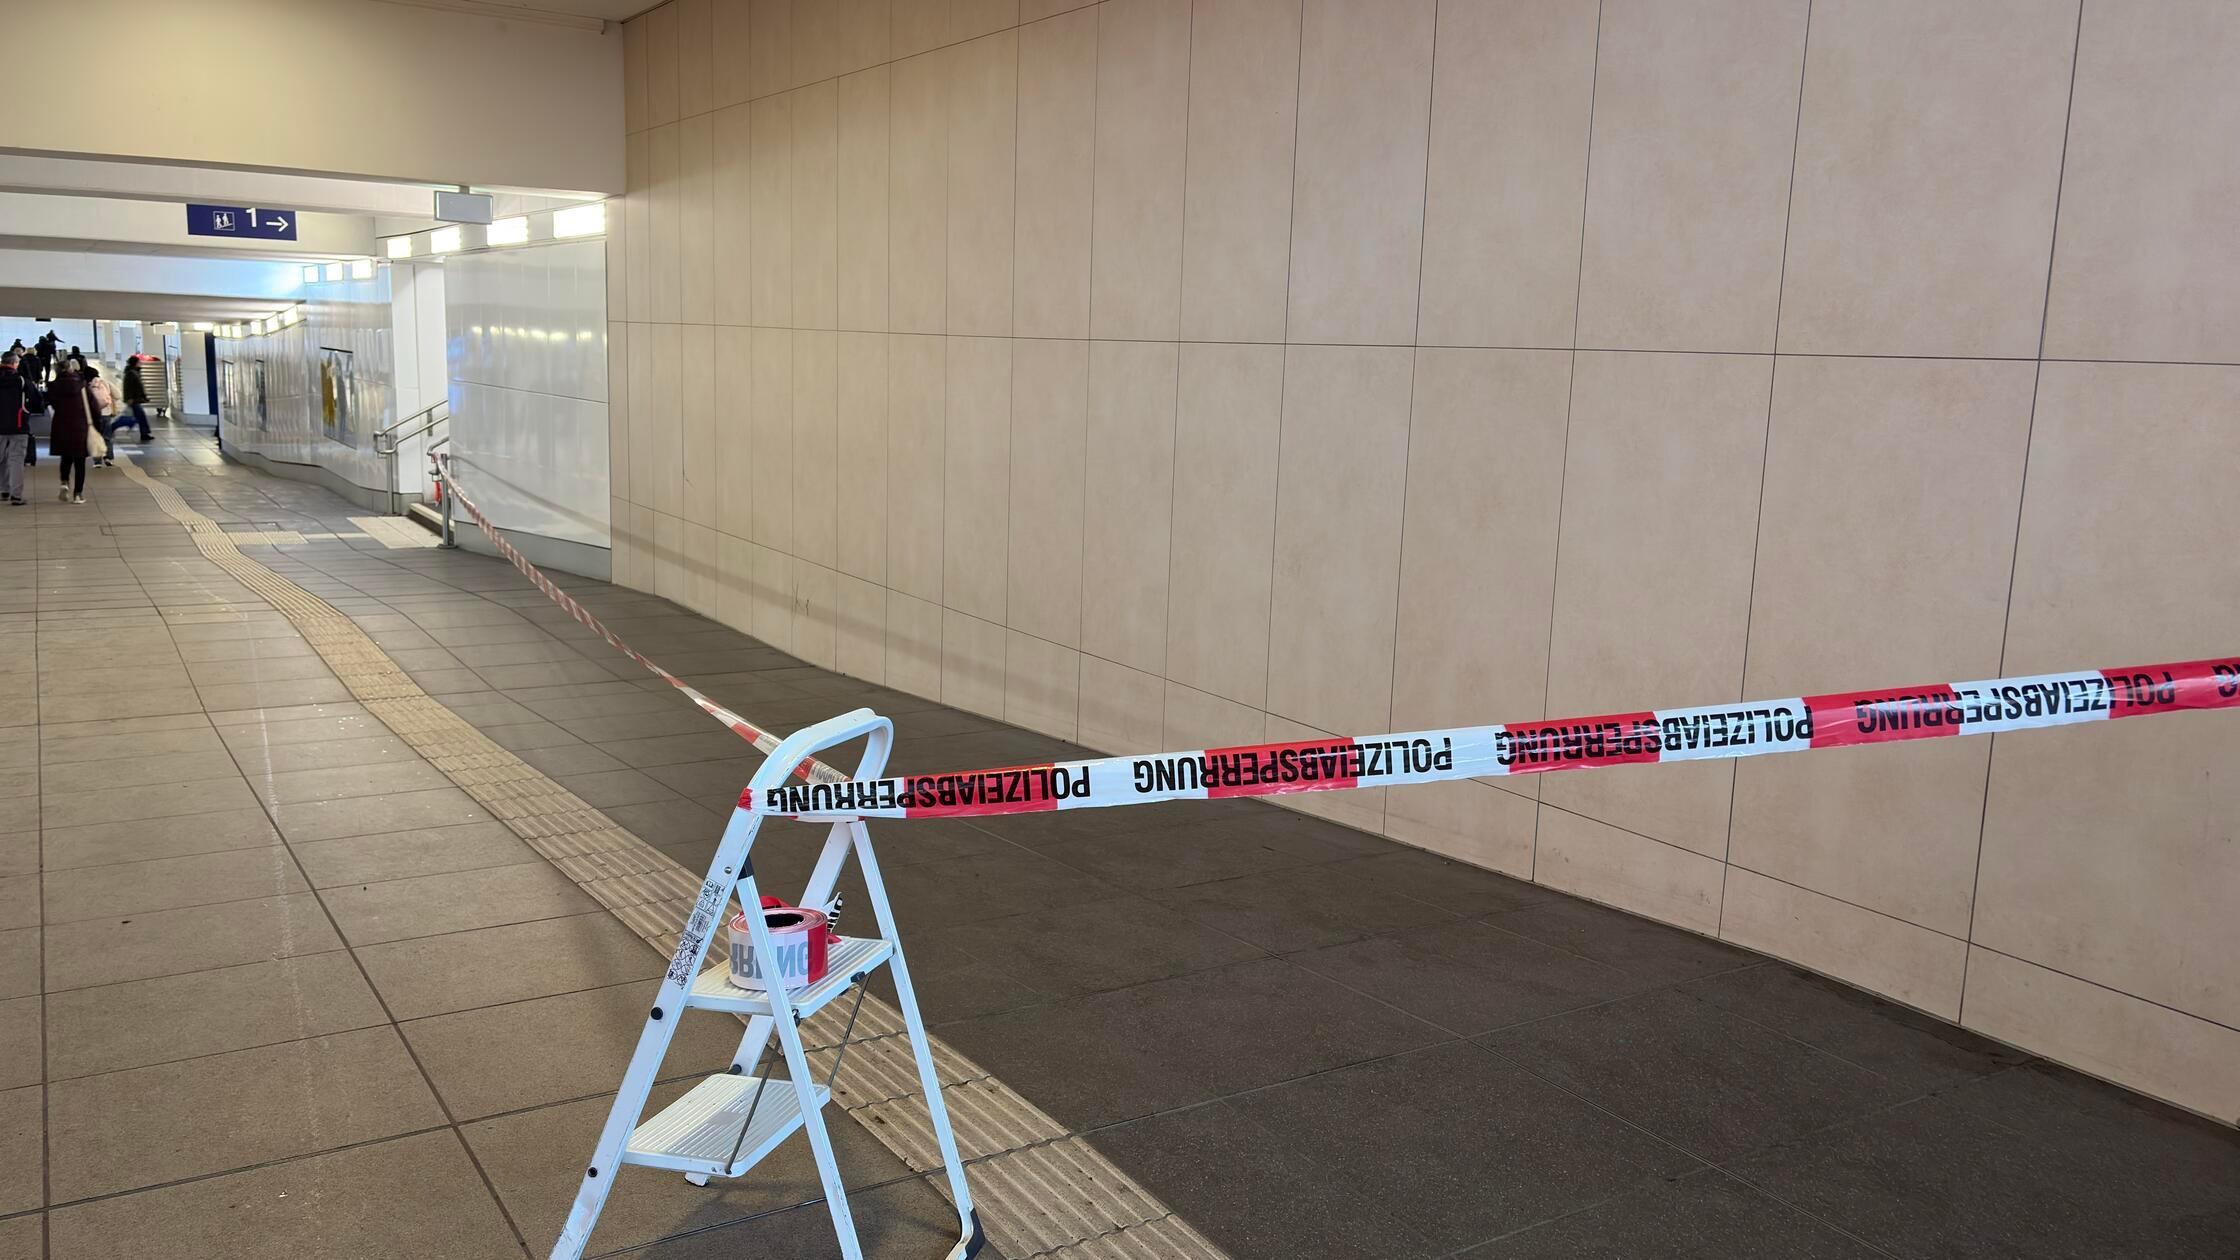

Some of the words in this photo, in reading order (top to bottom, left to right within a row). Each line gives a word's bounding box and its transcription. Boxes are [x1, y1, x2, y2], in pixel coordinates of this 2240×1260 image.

[245, 207, 257, 228] 1
[1853, 672, 2175, 734] POLIZEIABSPERRUNG
[1495, 705, 1814, 765] POLIZEIABSPERRUNG
[766, 766, 1090, 812] POLIZEIABSPERRUNG
[1133, 737, 1452, 793] POLIZEIABSPERRUNG
